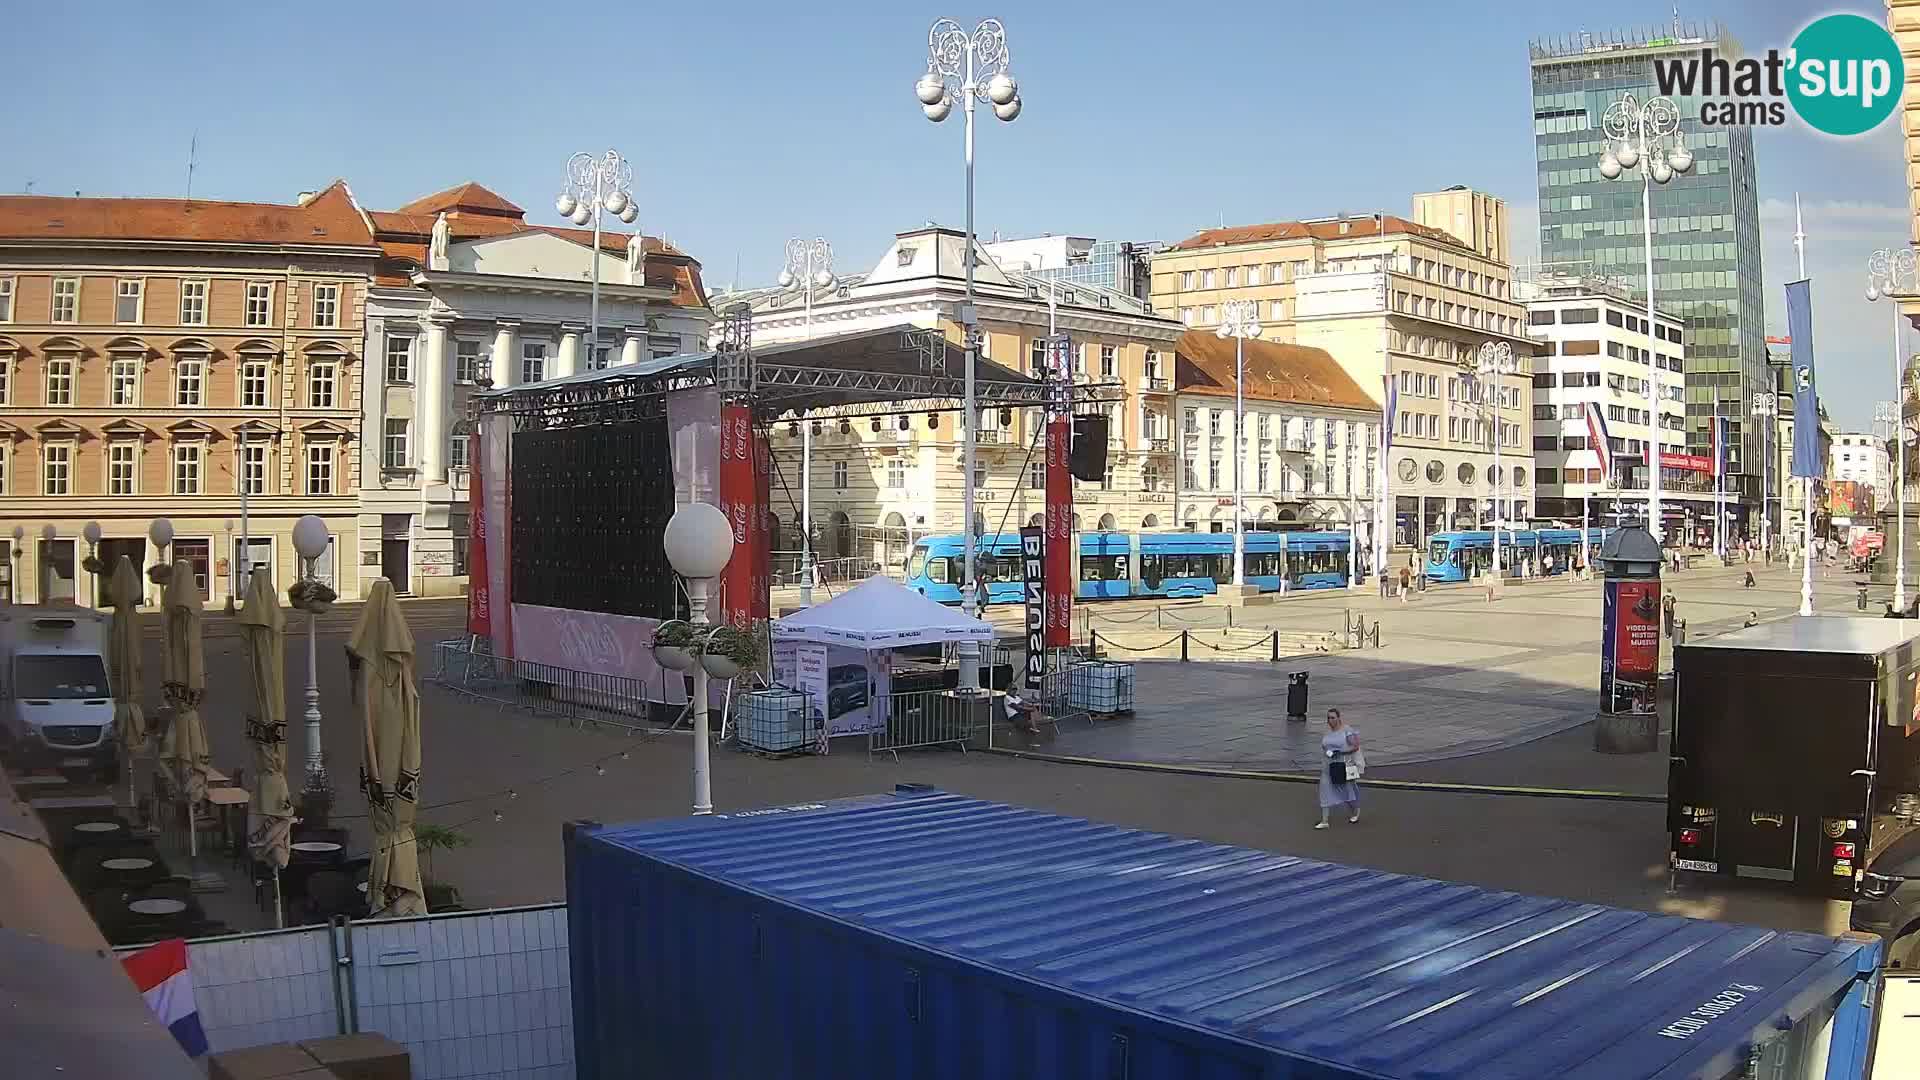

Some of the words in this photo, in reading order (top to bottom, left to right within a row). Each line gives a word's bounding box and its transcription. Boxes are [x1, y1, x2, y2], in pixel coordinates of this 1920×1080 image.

[1138, 494, 1166, 503] SINGER
[1657, 1016, 1708, 1039] MCDU
[1690, 990, 1747, 1019] 300629
